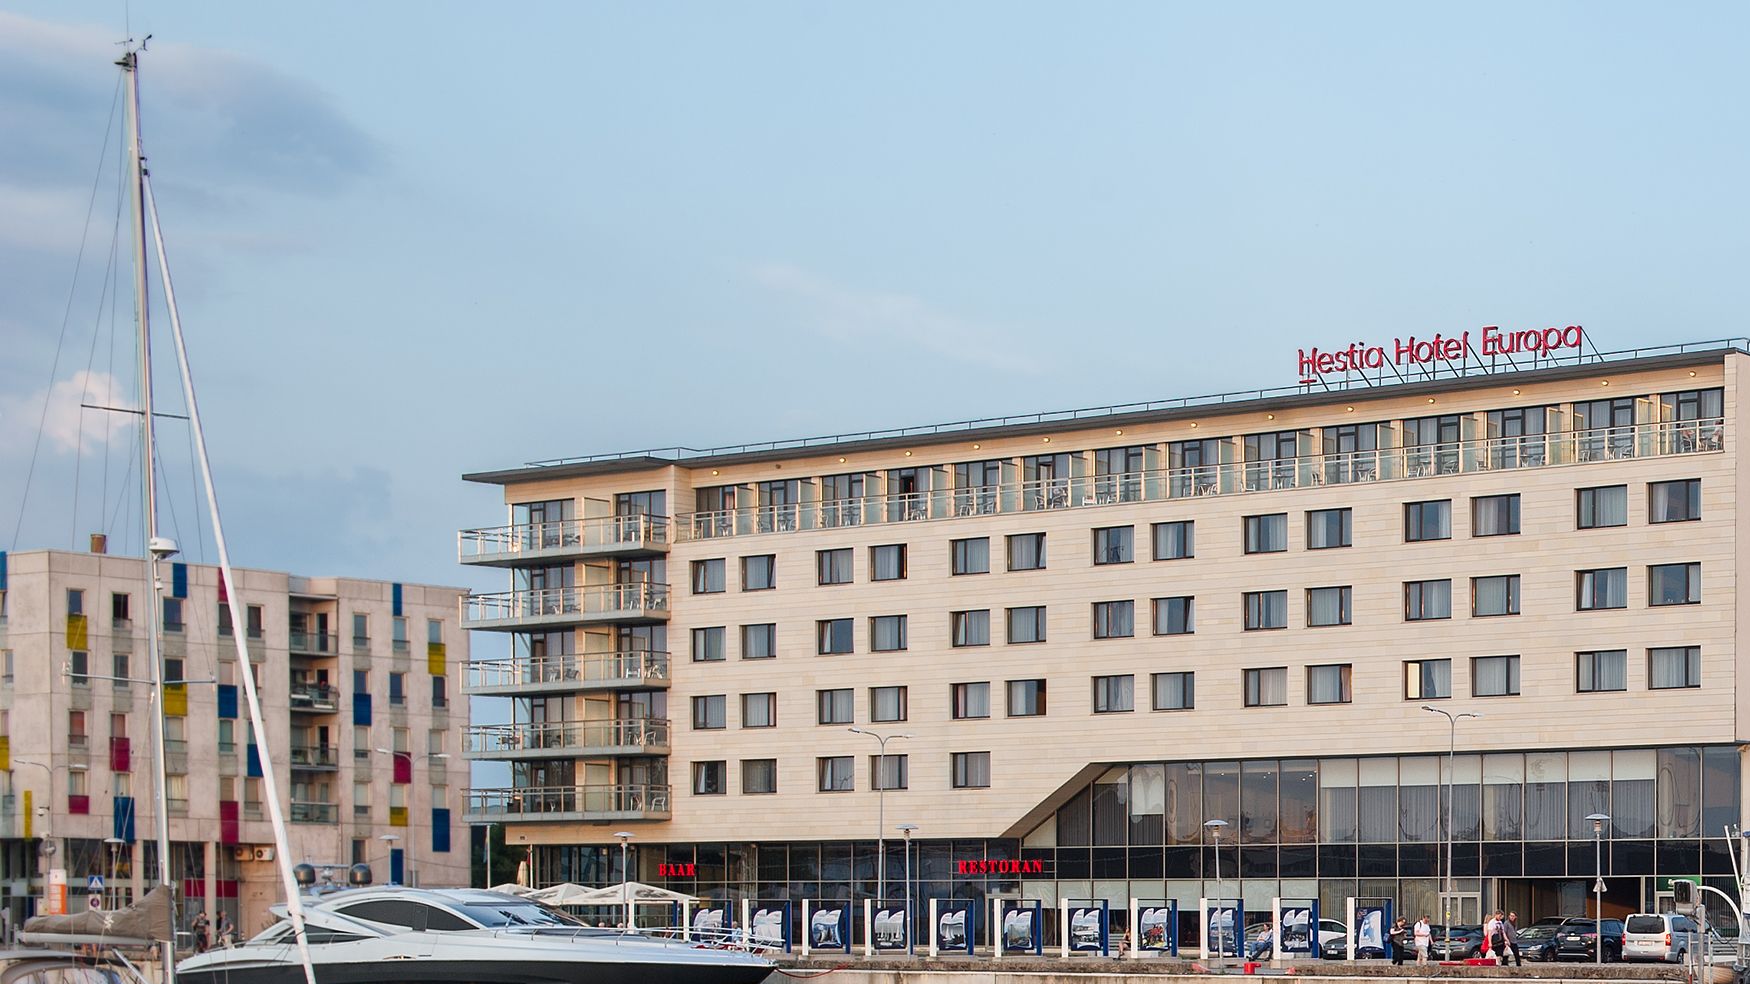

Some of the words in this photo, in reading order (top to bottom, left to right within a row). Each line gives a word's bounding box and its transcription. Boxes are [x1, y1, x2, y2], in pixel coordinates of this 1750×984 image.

[1298, 341, 1384, 377] Hestia
[1394, 330, 1470, 366] Hotel
[1482, 324, 1584, 358] Europa
[658, 863, 696, 877] BAAR
[958, 859, 1044, 875] RESTORAN
